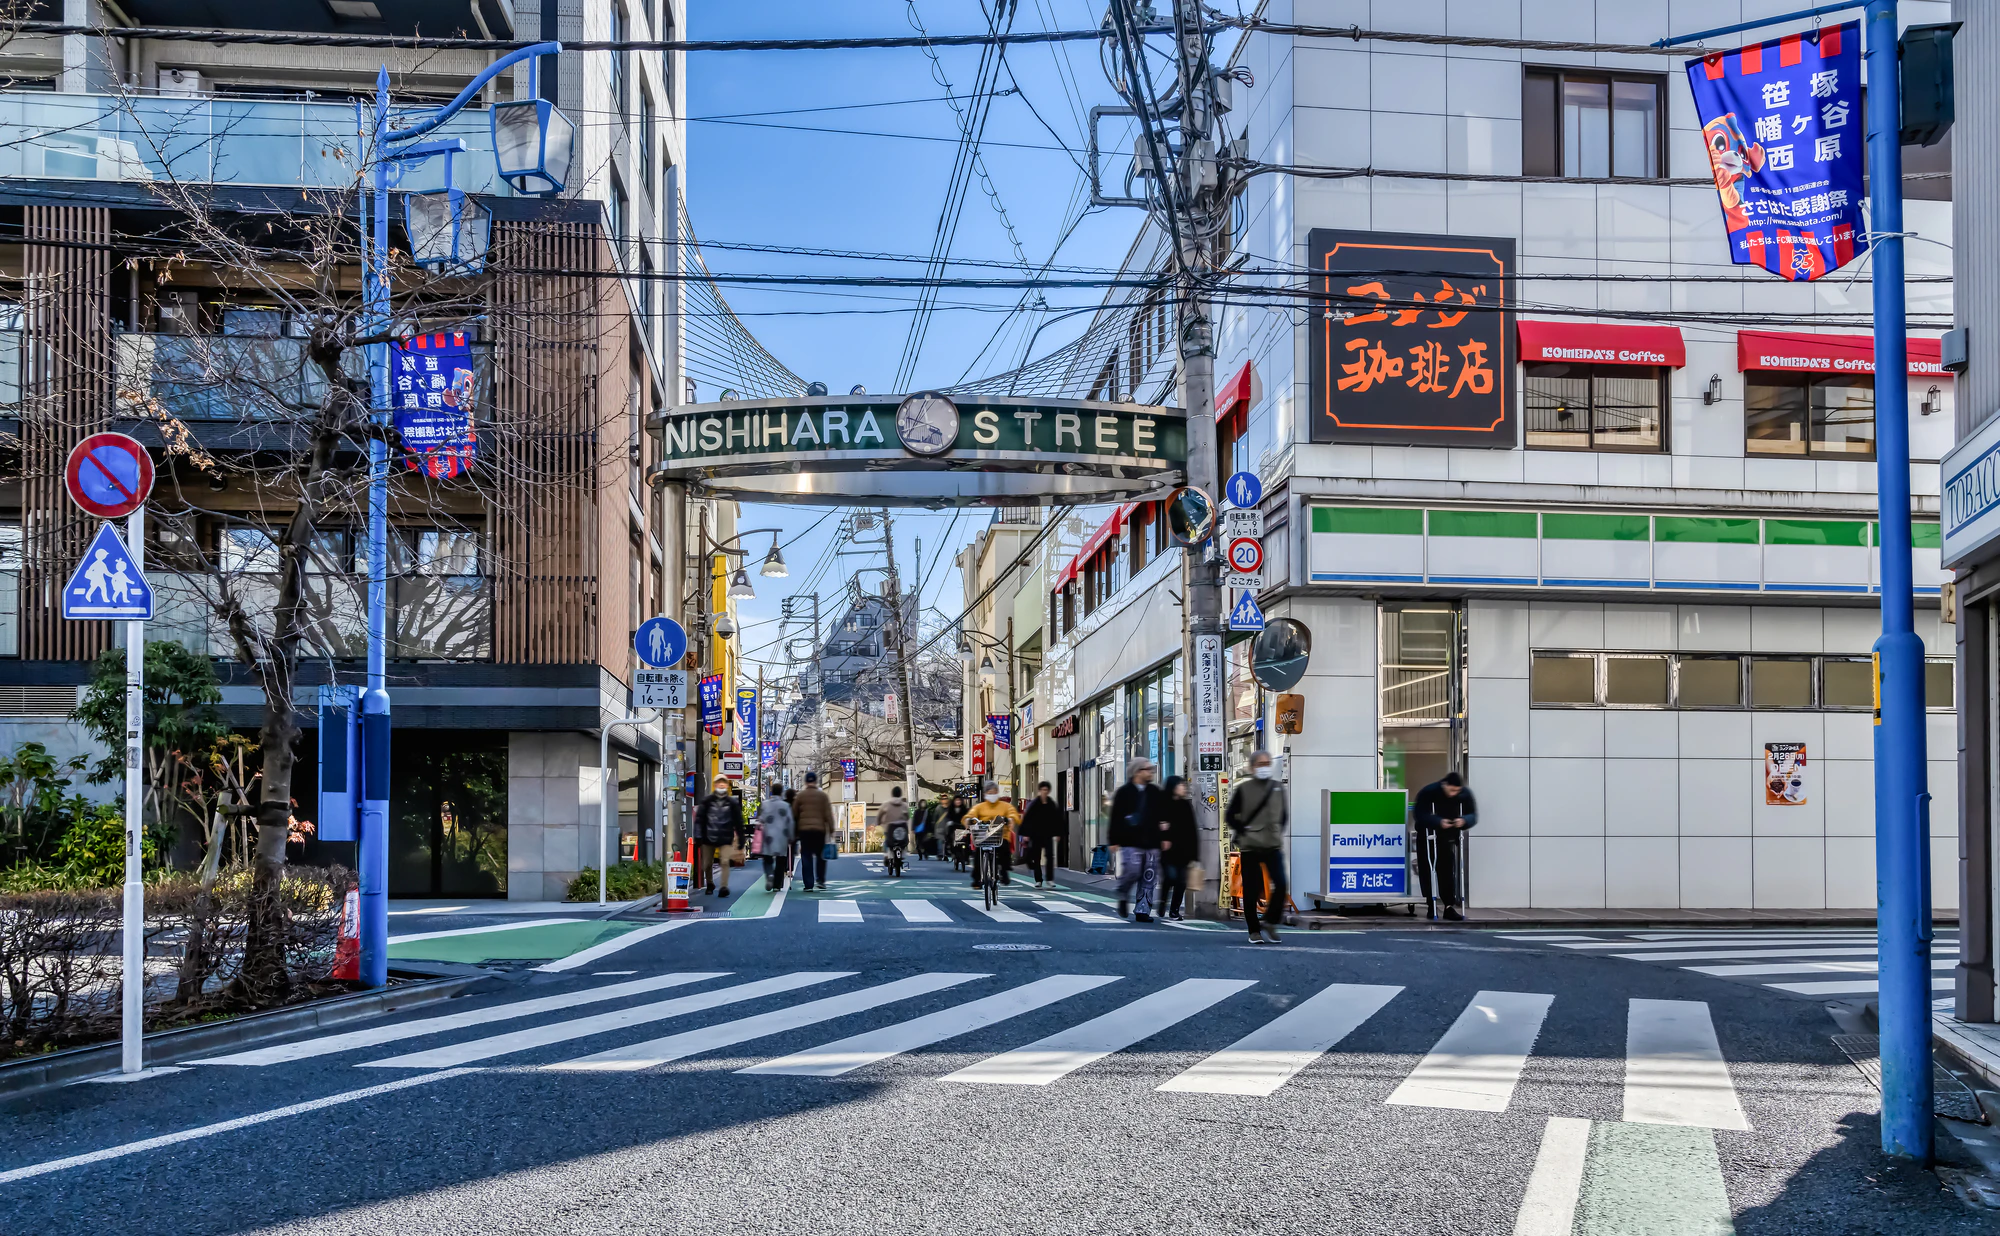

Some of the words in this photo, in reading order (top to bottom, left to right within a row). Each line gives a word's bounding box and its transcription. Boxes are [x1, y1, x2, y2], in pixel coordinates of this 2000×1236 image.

[1740, 189, 1849, 217] ささはた感謝祭
[1542, 347, 1615, 360] KOMEDA'S
[1618, 350, 1665, 362] Coffee
[1760, 355, 1830, 369] KOMEDA'S
[1337, 338, 1494, 399] 珈琲店
[665, 410, 884, 455] NISHIHARA
[1229, 512, 1261, 520] 自転車を除く
[1235, 547, 1256, 564] 20
[1230, 577, 1261, 586] ここから
[636, 673, 685, 684] 自転車を除く
[1201, 652, 1212, 714] 矢澤クリニック渋谷
[742, 699, 753, 747] クリーニング
[1332, 834, 1403, 849] FamilyMart
[1341, 871, 1357, 889] 酒
[1362, 873, 1393, 887] たばこ
